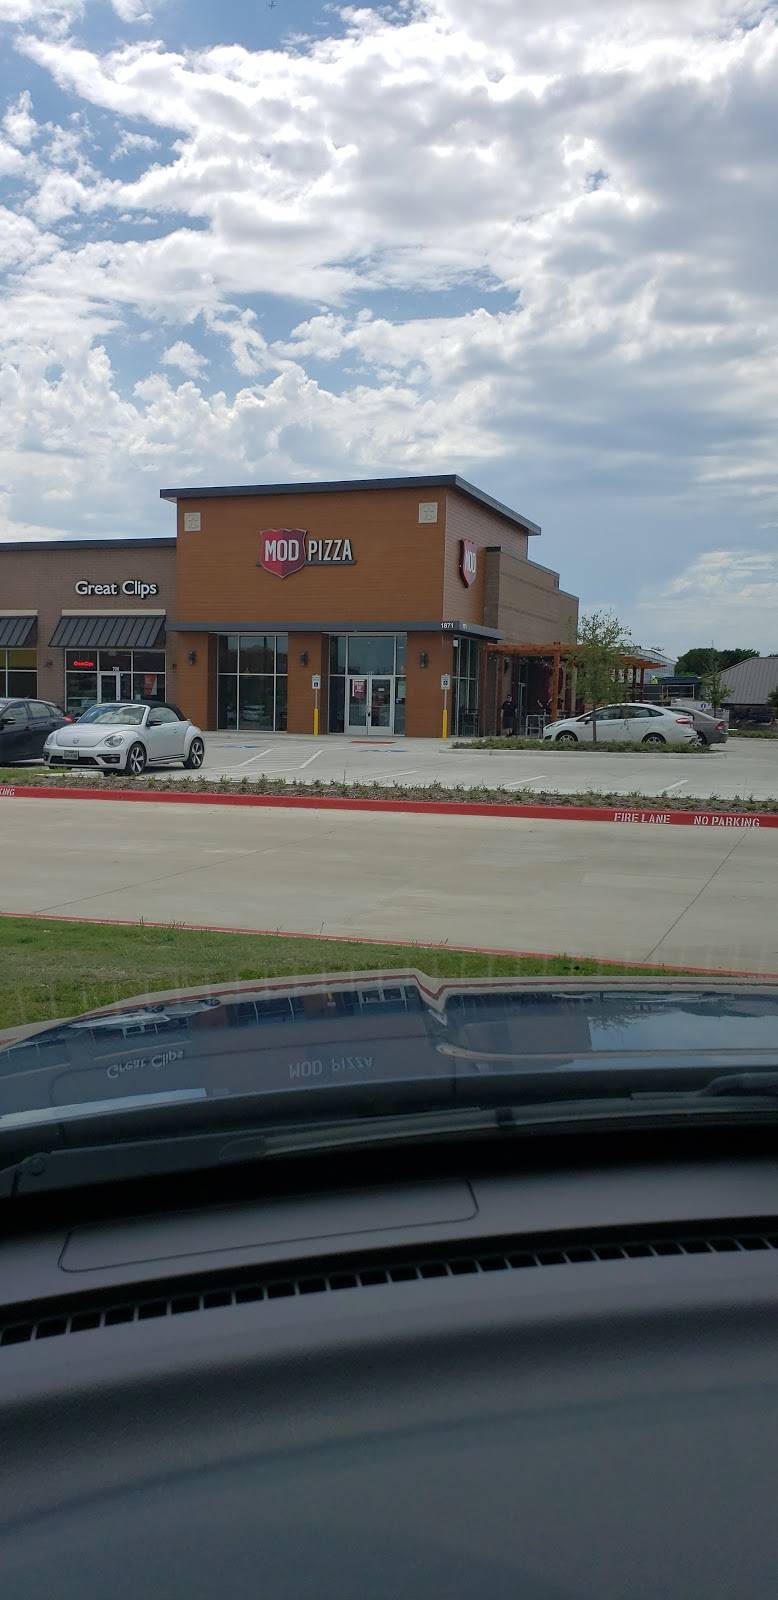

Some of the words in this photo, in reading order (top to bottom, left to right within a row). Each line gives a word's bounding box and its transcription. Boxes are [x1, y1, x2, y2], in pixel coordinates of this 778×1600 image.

[264, 539, 300, 562] MOD
[308, 539, 353, 561] PIZZA
[75, 580, 118, 595] Great
[122, 580, 158, 599] Clips
[613, 812, 639, 823] FIRE
[641, 813, 671, 824] LANE
[693, 815, 709, 826] NO
[711, 815, 760, 828] PARKING
